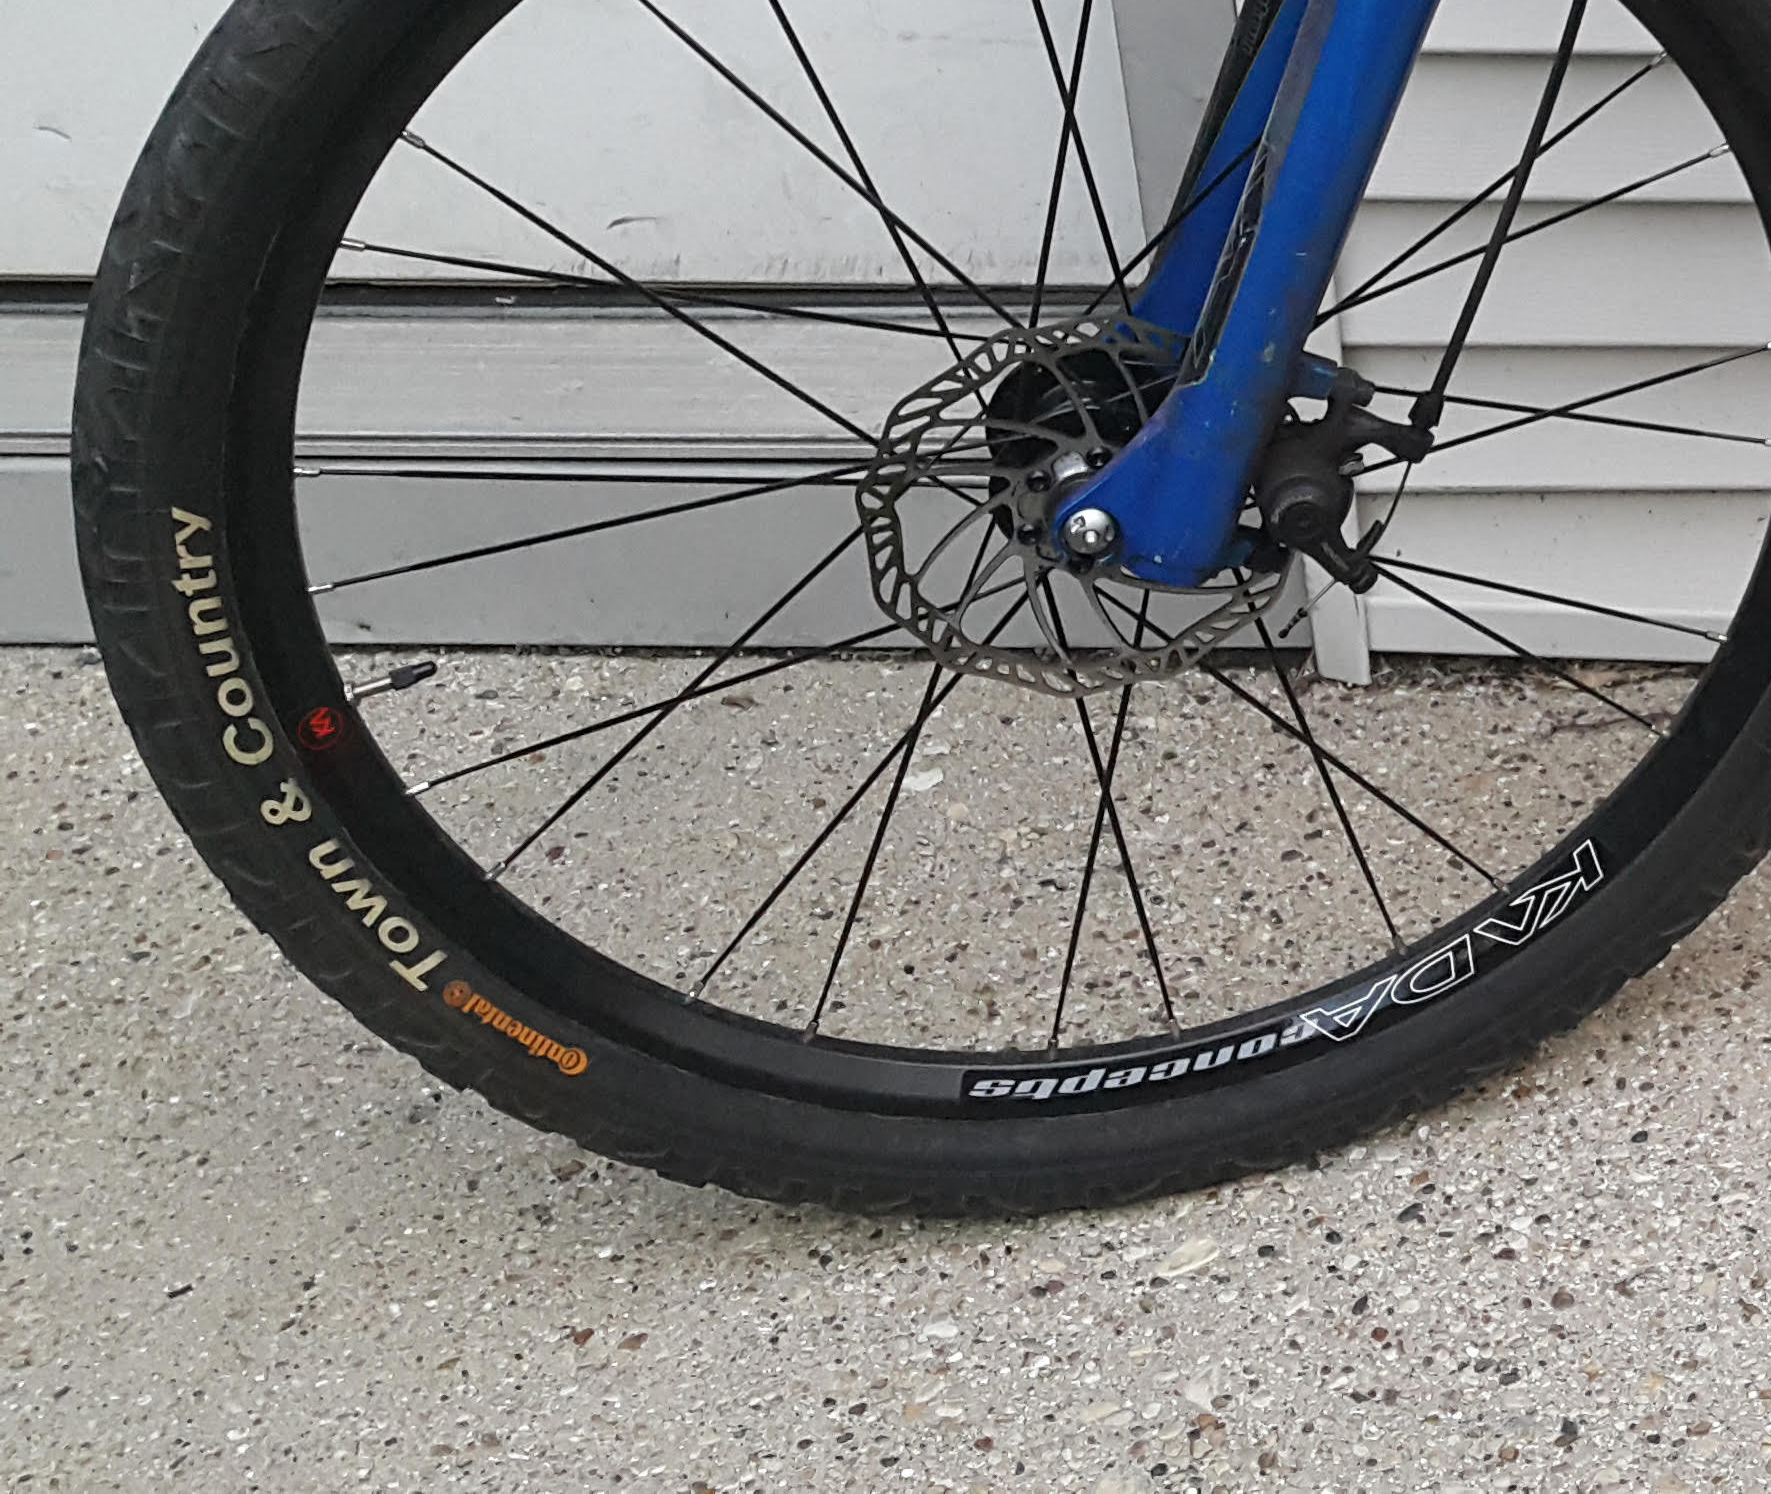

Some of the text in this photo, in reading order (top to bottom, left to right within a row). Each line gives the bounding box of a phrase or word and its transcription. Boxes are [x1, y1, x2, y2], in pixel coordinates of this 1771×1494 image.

[170, 506, 449, 993] Town & Country
